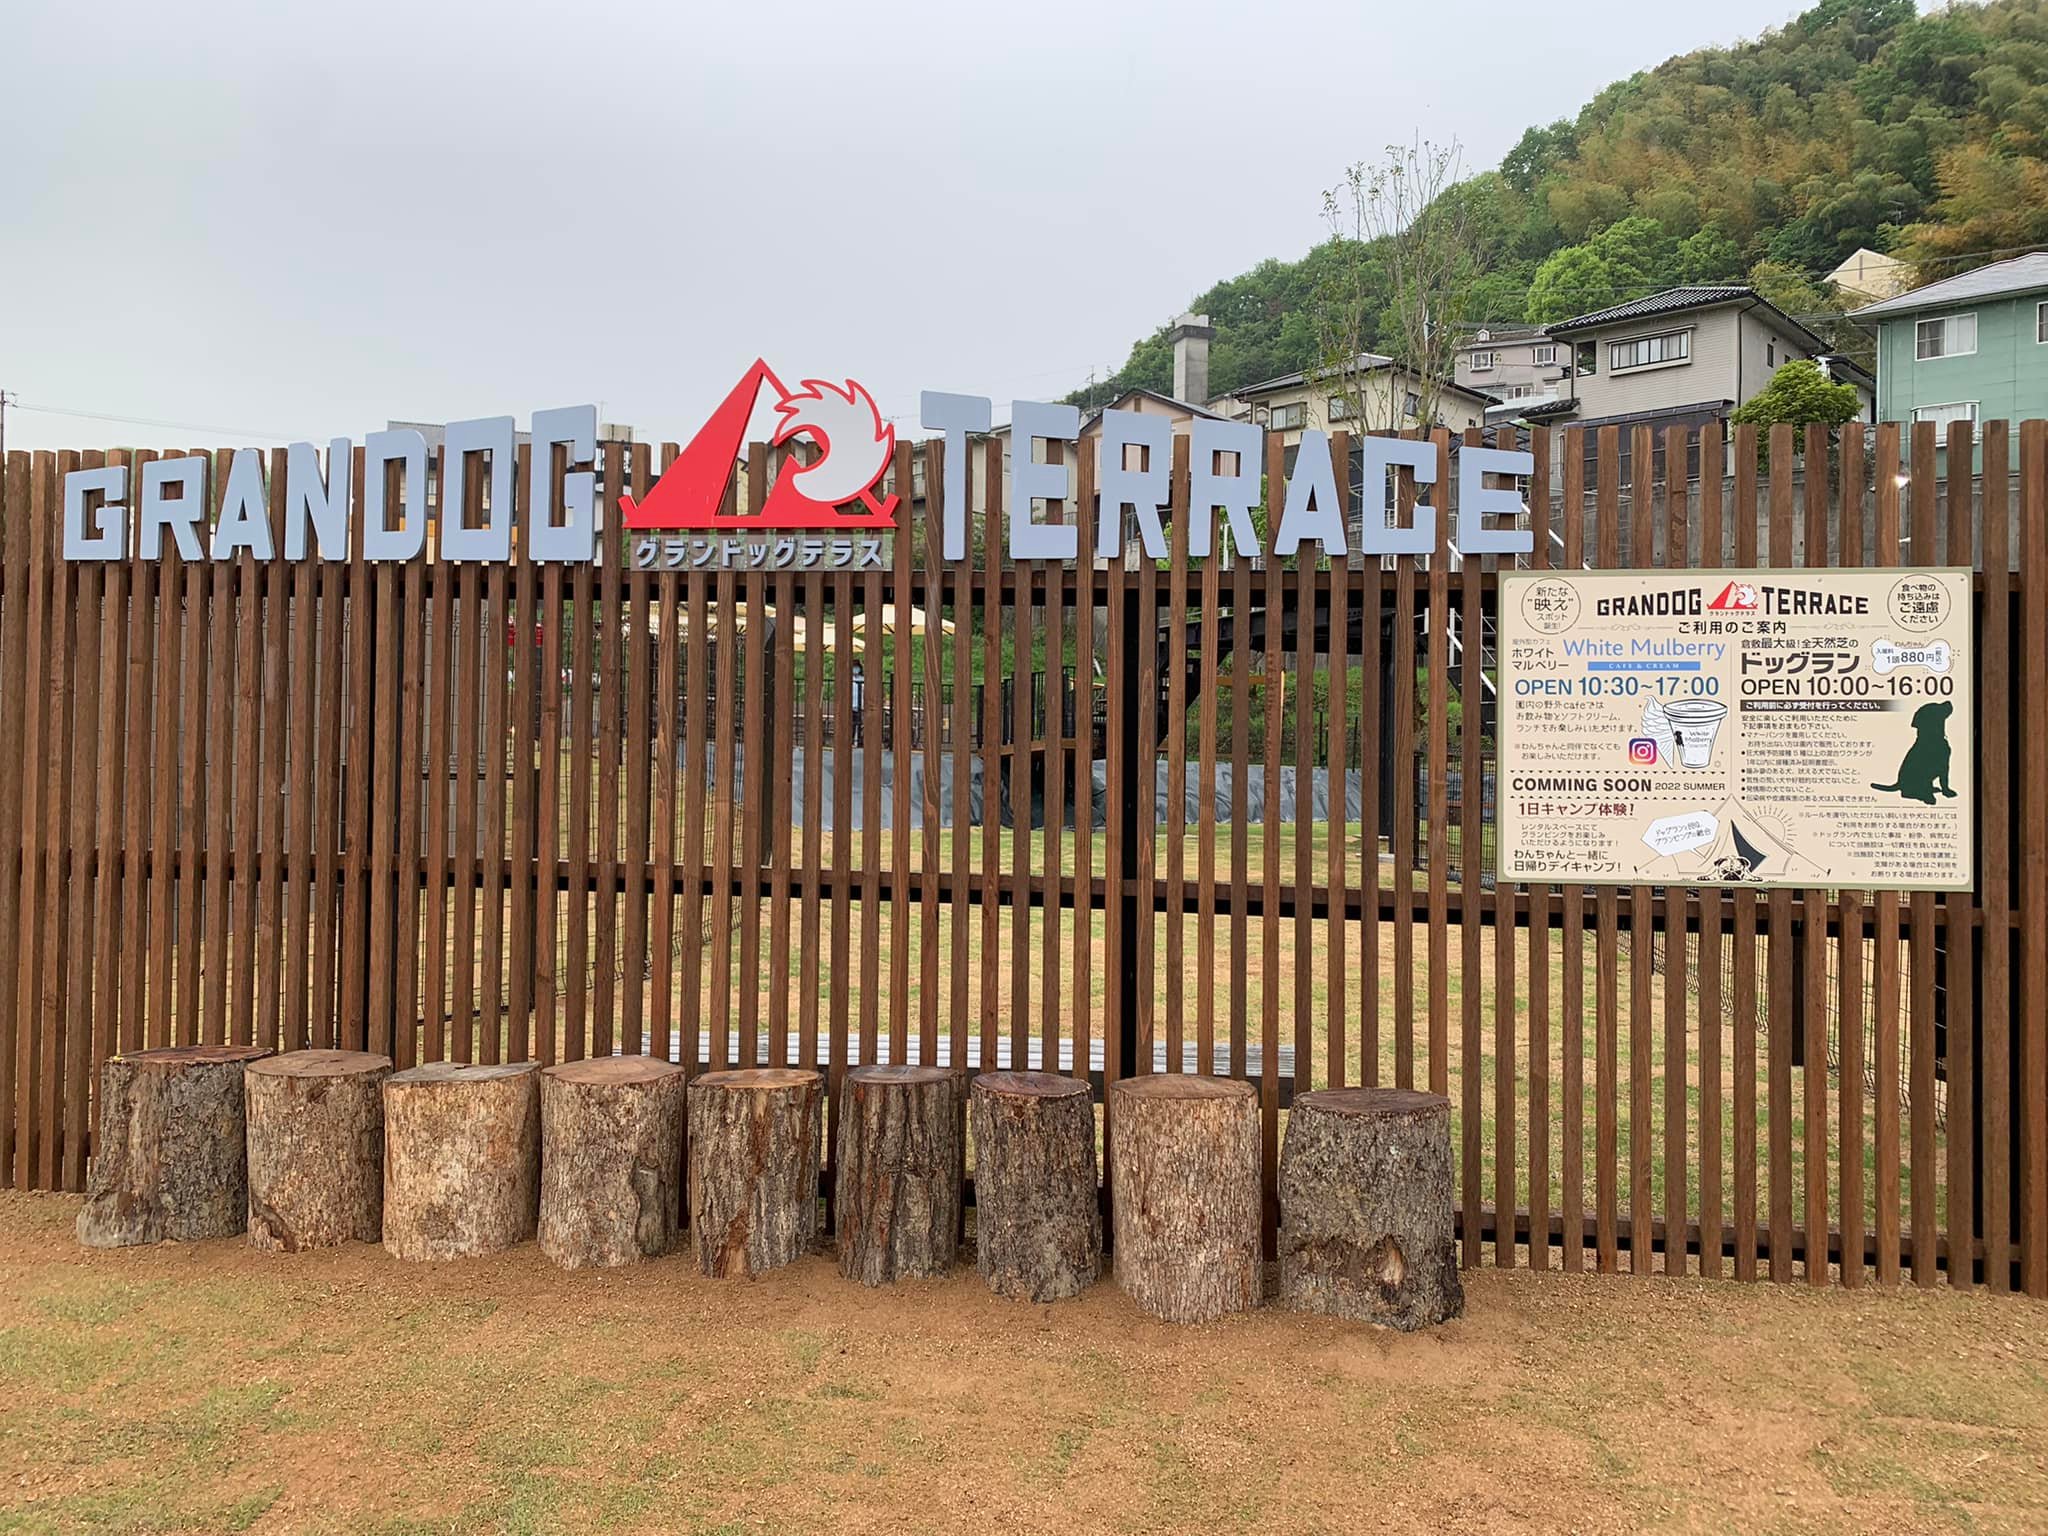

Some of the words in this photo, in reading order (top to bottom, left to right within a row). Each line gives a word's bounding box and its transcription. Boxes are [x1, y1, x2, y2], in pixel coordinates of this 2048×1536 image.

[64, 404, 596, 561] GRANDOG
[920, 390, 1534, 560] TERRACE
[636, 536, 884, 567] グランドッグテラス
[1536, 586, 1569, 597] 新たな
[1901, 583, 1936, 592] 食べ物の
[1597, 588, 1702, 616] GRANDOG
[1761, 586, 1869, 615] TERRACE
[1896, 592, 1940, 601] 持ち込みは
[1900, 601, 1939, 613] ご遠慮
[1536, 613, 1568, 621] スポット
[1900, 614, 1938, 624] ください
[1678, 620, 1787, 635] ご利用のご案内
[1512, 648, 1554, 658] ホワイト
[1563, 638, 1623, 656] White
[1631, 638, 1726, 661] Mulberry
[1512, 660, 1569, 671] マルベリー
[1741, 651, 1860, 675] ドッグラン
[1515, 679, 1572, 696] OPEN
[1741, 679, 1800, 695] OPEN
[1512, 777, 1597, 792] COMMING
[1603, 778, 1652, 792] SOON
[1655, 782, 1681, 791] 2022
[1683, 782, 1726, 791] SUMMER
[1518, 802, 1634, 816] 1日キャンプ体験!
[1521, 831, 1606, 839] グランピングをお楽しみ
[1514, 849, 1609, 861] わんちゃんと一緒に
